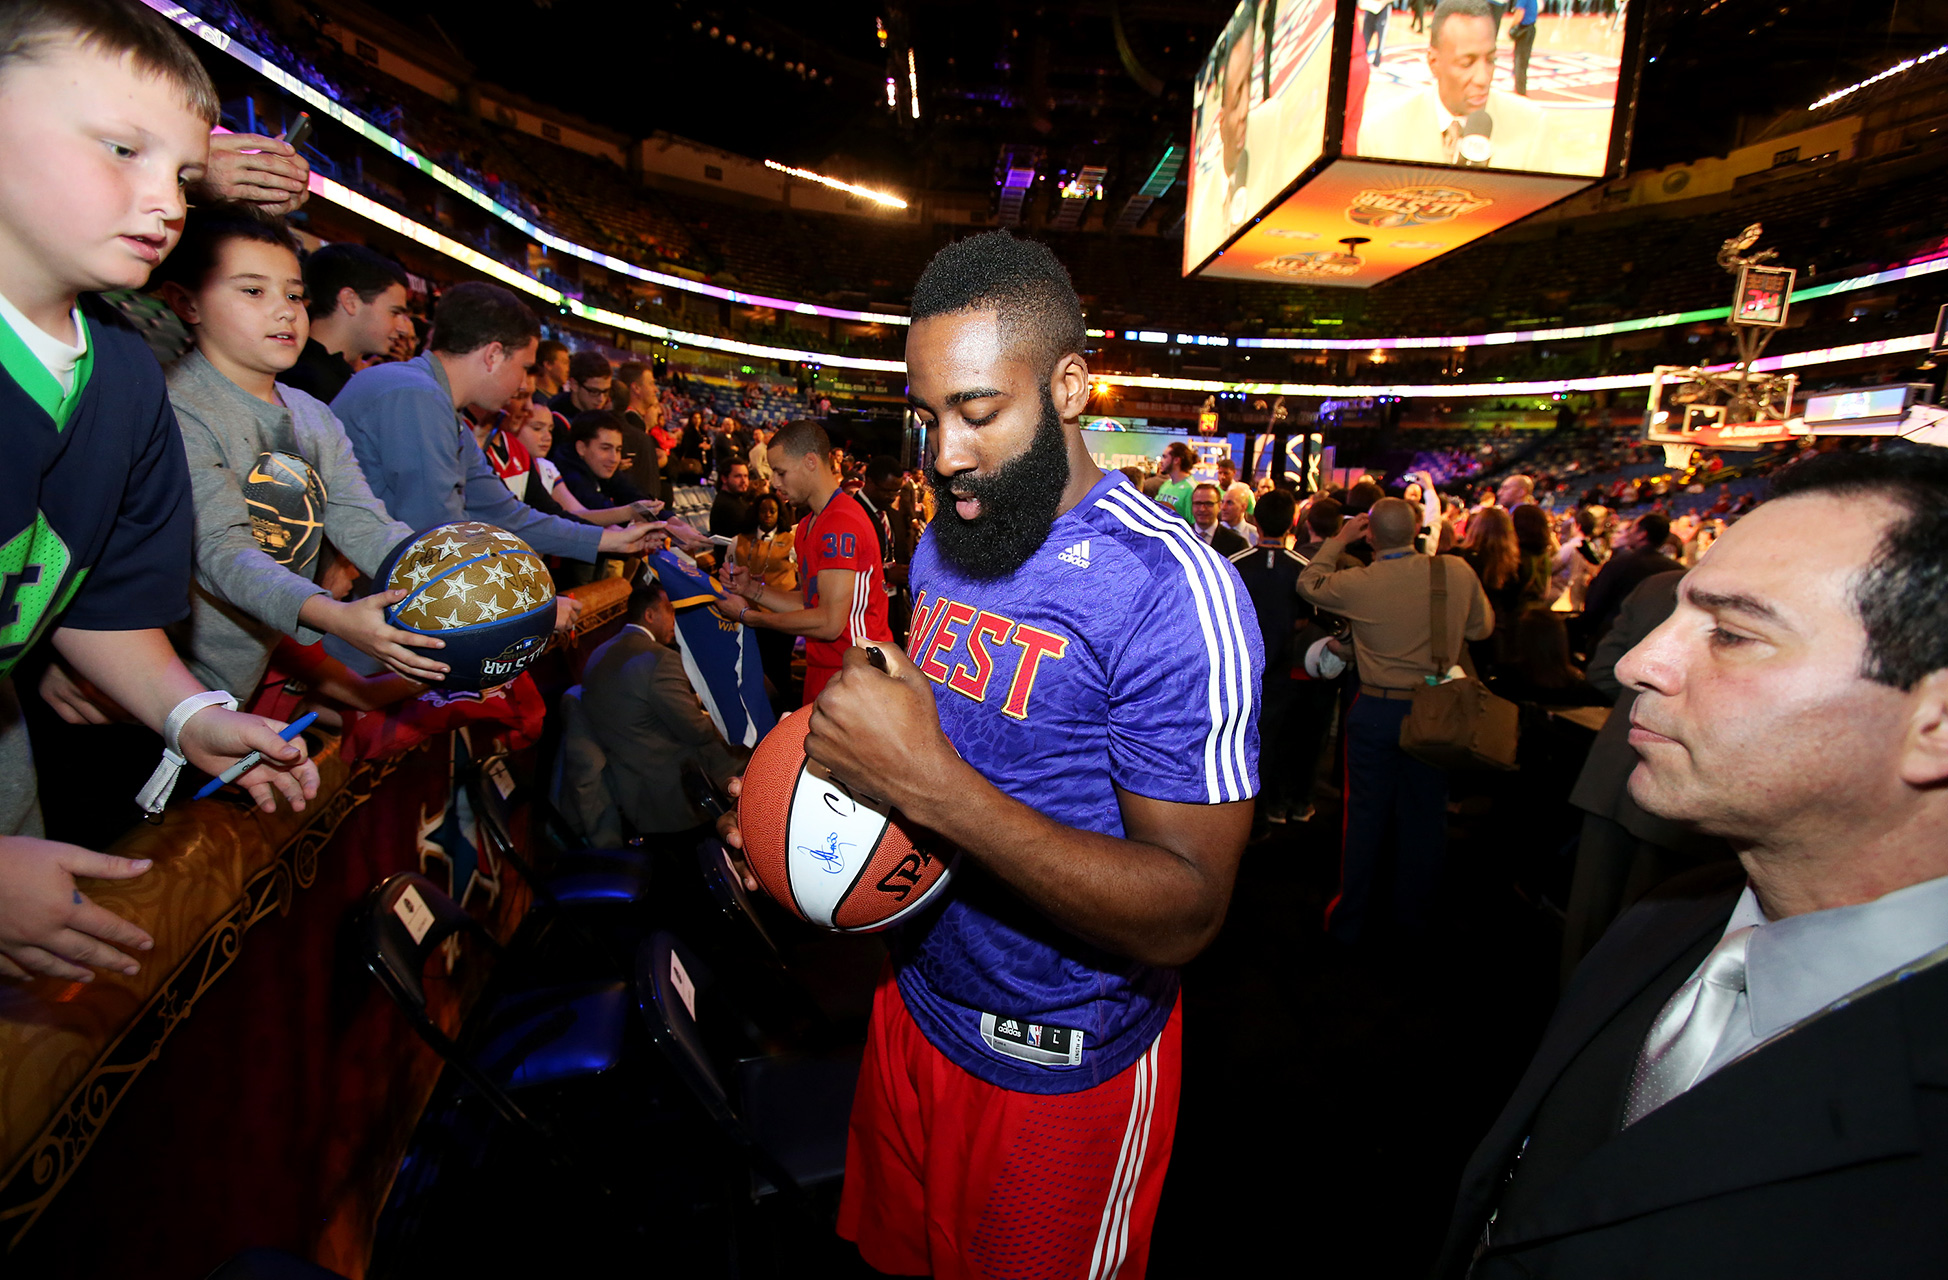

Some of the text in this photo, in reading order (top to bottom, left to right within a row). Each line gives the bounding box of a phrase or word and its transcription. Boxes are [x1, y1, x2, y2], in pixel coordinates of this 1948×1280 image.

[822, 532, 856, 559] 30
[1058, 552, 1091, 569] adidas
[906, 589, 1070, 721] WEST
[998, 1025, 1021, 1038] adidas
[1053, 1033, 1060, 1044] L
